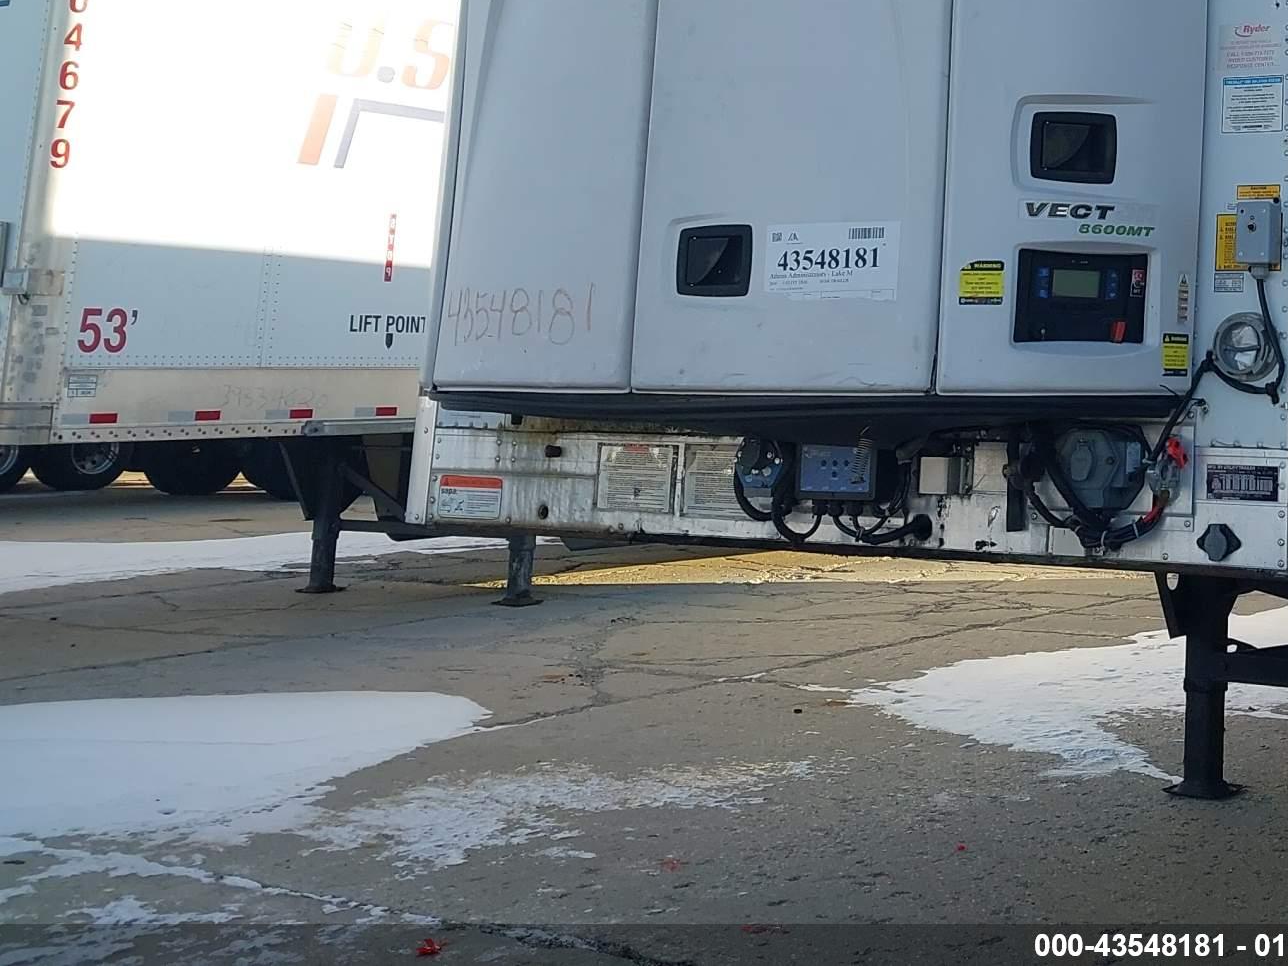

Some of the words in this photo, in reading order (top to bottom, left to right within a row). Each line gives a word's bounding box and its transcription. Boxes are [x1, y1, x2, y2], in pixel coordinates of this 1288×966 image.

[1243, 24, 1271, 35] Ryder
[1025, 202, 1115, 220] VECT
[1078, 223, 1155, 237] 8600MT
[777, 247, 880, 272] 43548181
[350, 315, 381, 333] LIFT
